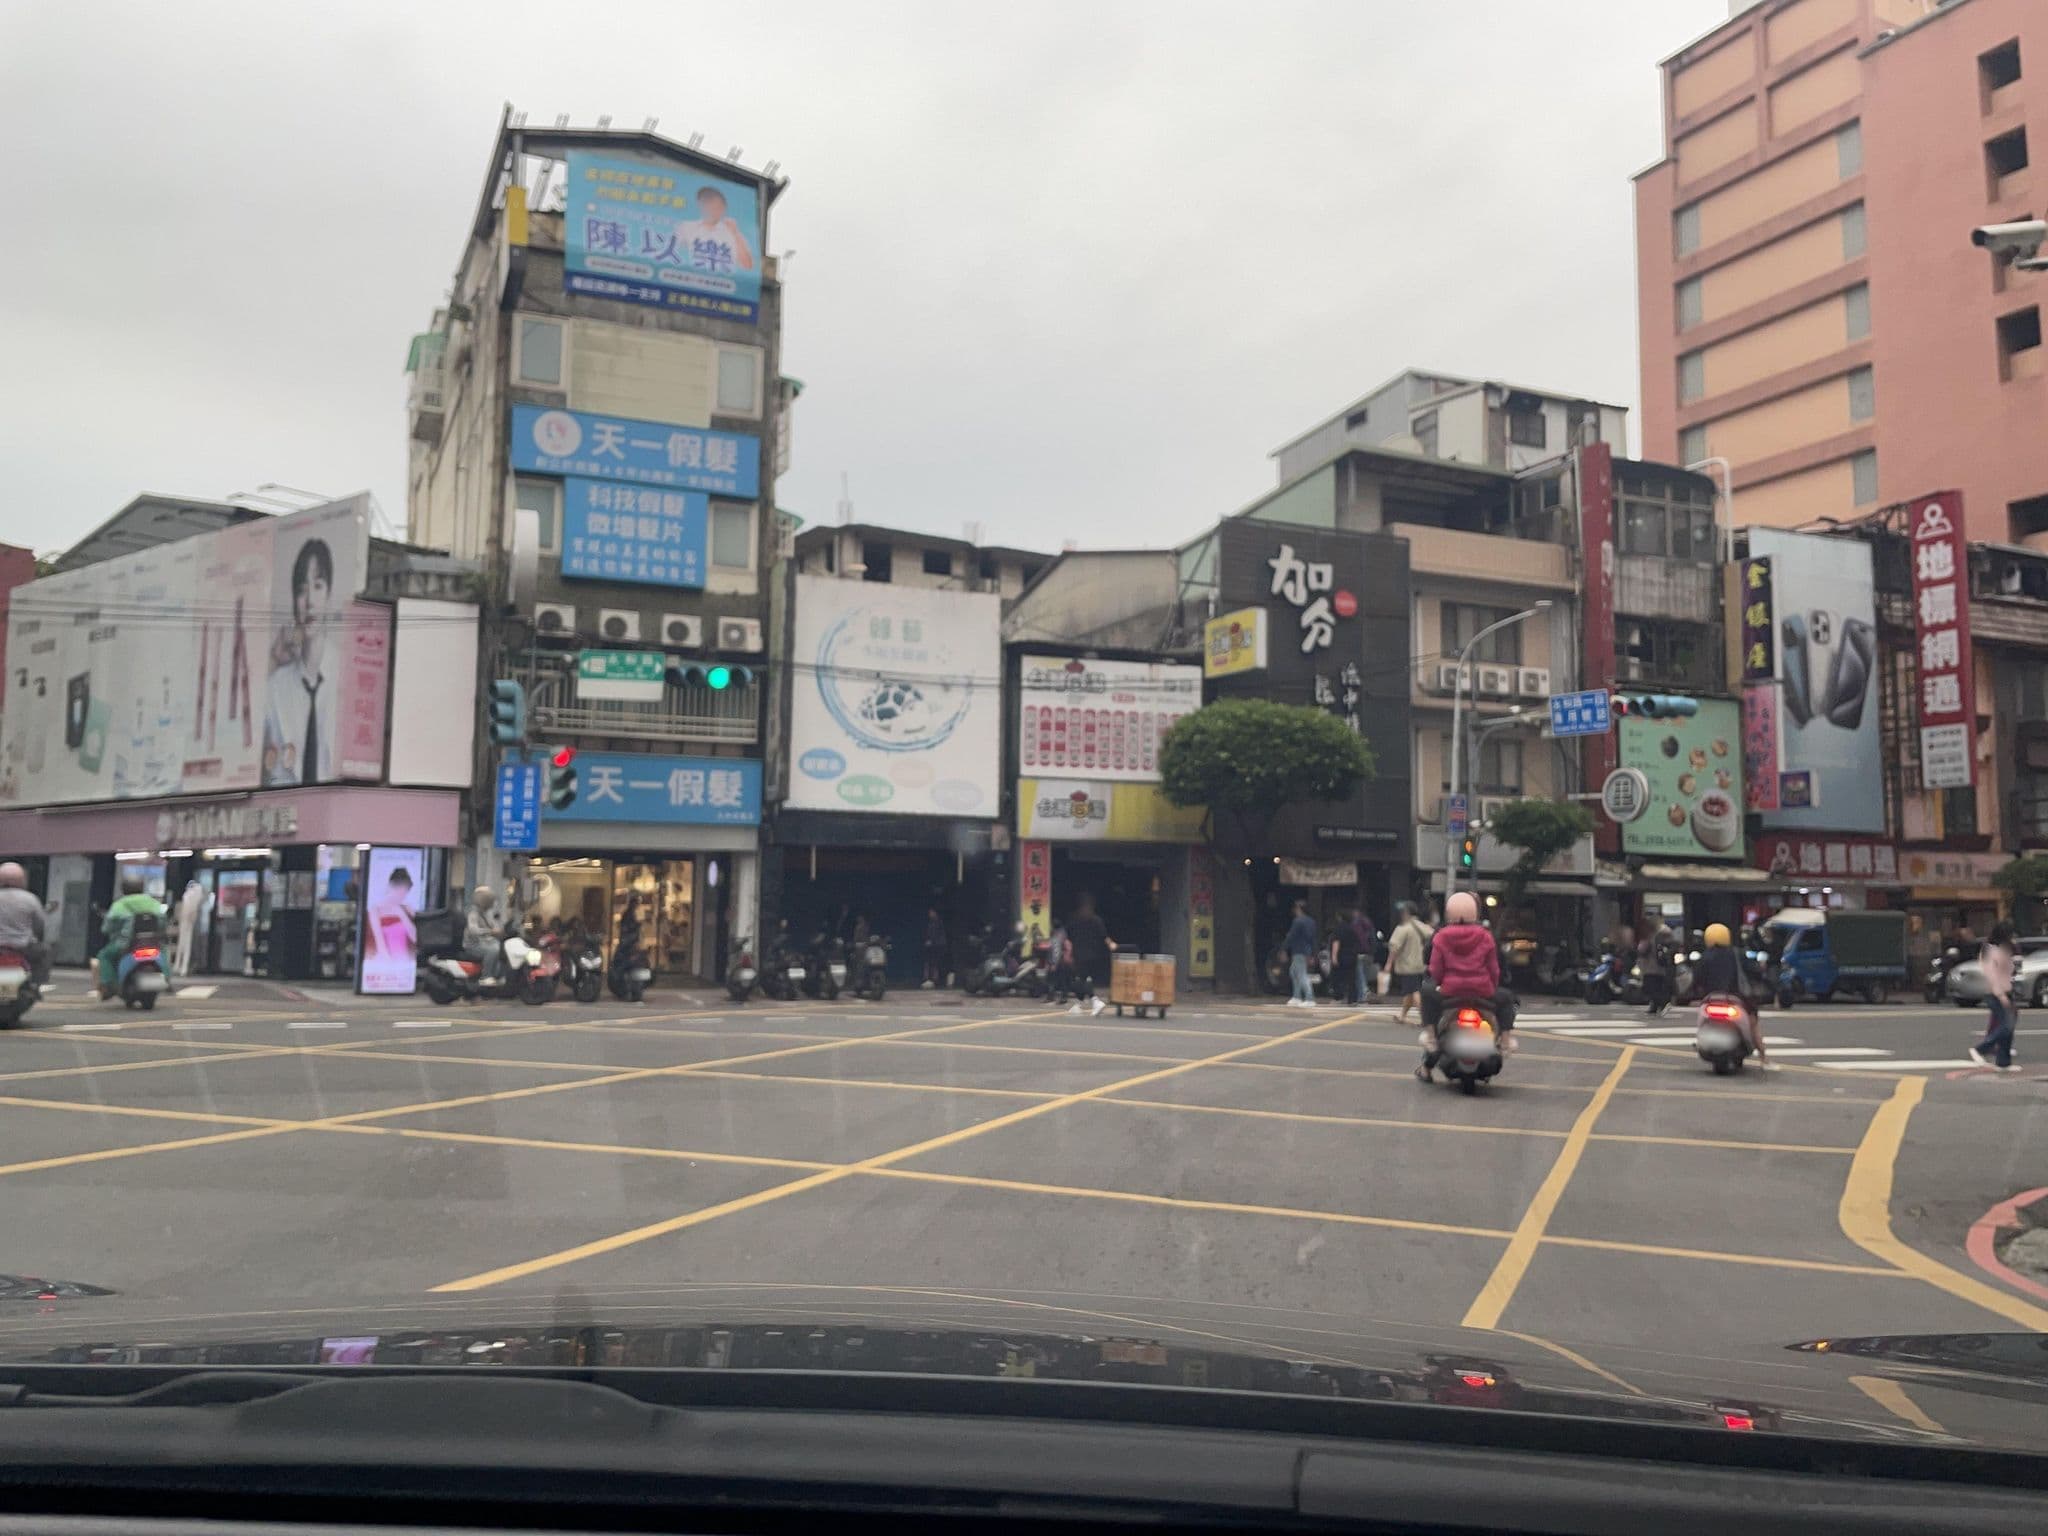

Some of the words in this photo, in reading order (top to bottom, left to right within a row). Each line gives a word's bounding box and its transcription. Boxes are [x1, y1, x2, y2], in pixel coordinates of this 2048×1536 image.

[587, 218, 735, 272] 陳以樂
[591, 422, 738, 474] 天一假髮
[1916, 540, 1962, 715] 地標網通
[587, 766, 743, 807] 天一假髮
